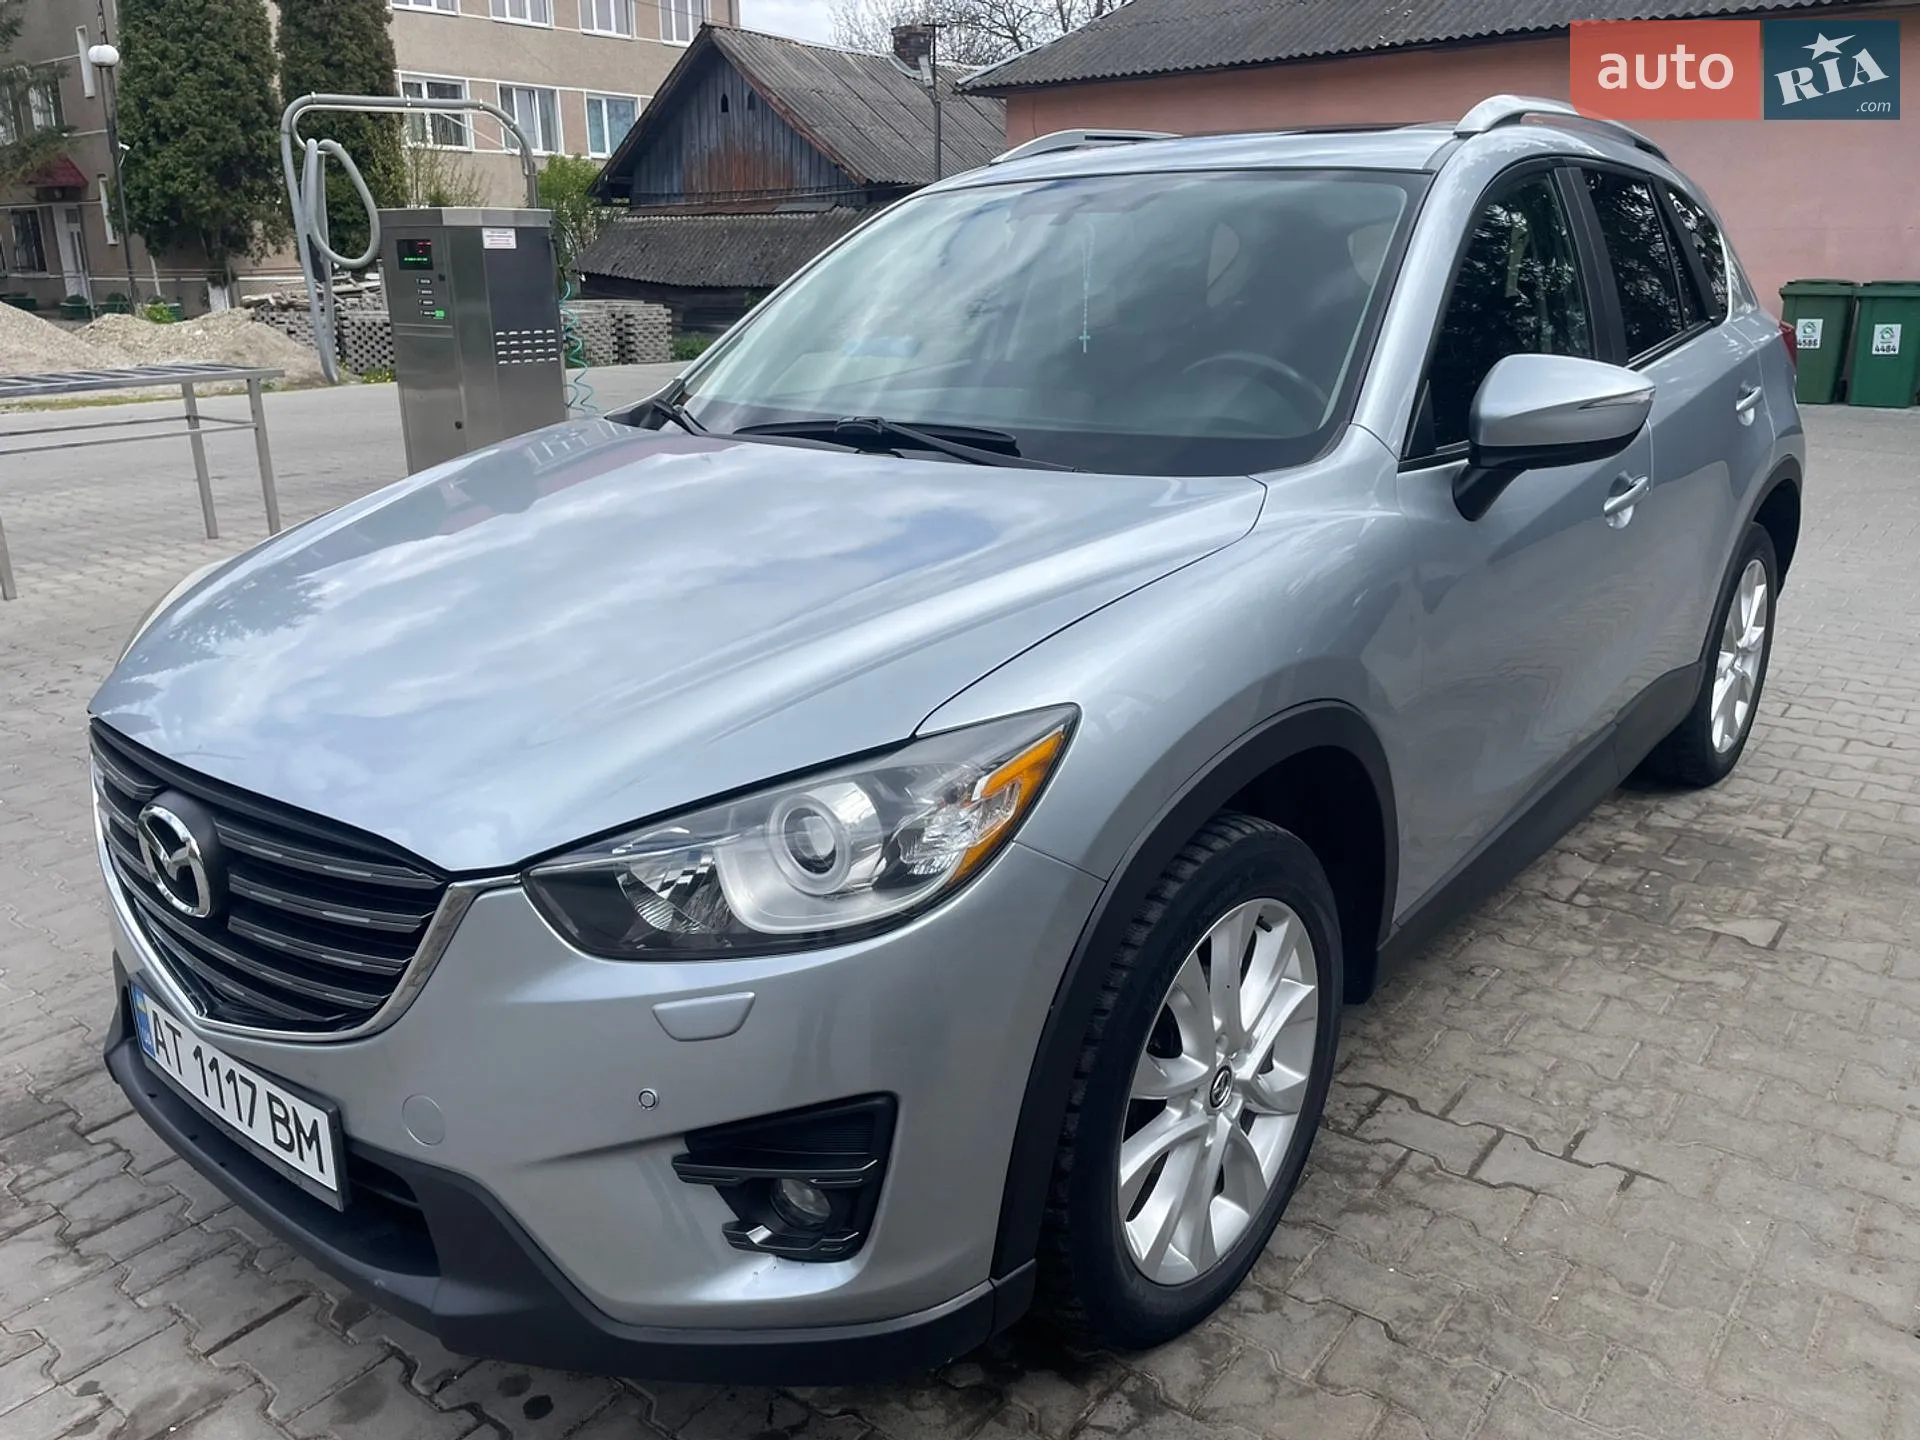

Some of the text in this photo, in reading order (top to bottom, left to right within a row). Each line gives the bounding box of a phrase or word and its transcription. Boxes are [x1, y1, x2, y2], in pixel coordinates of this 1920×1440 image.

[152, 1009, 325, 1175] AT 1117 BM
